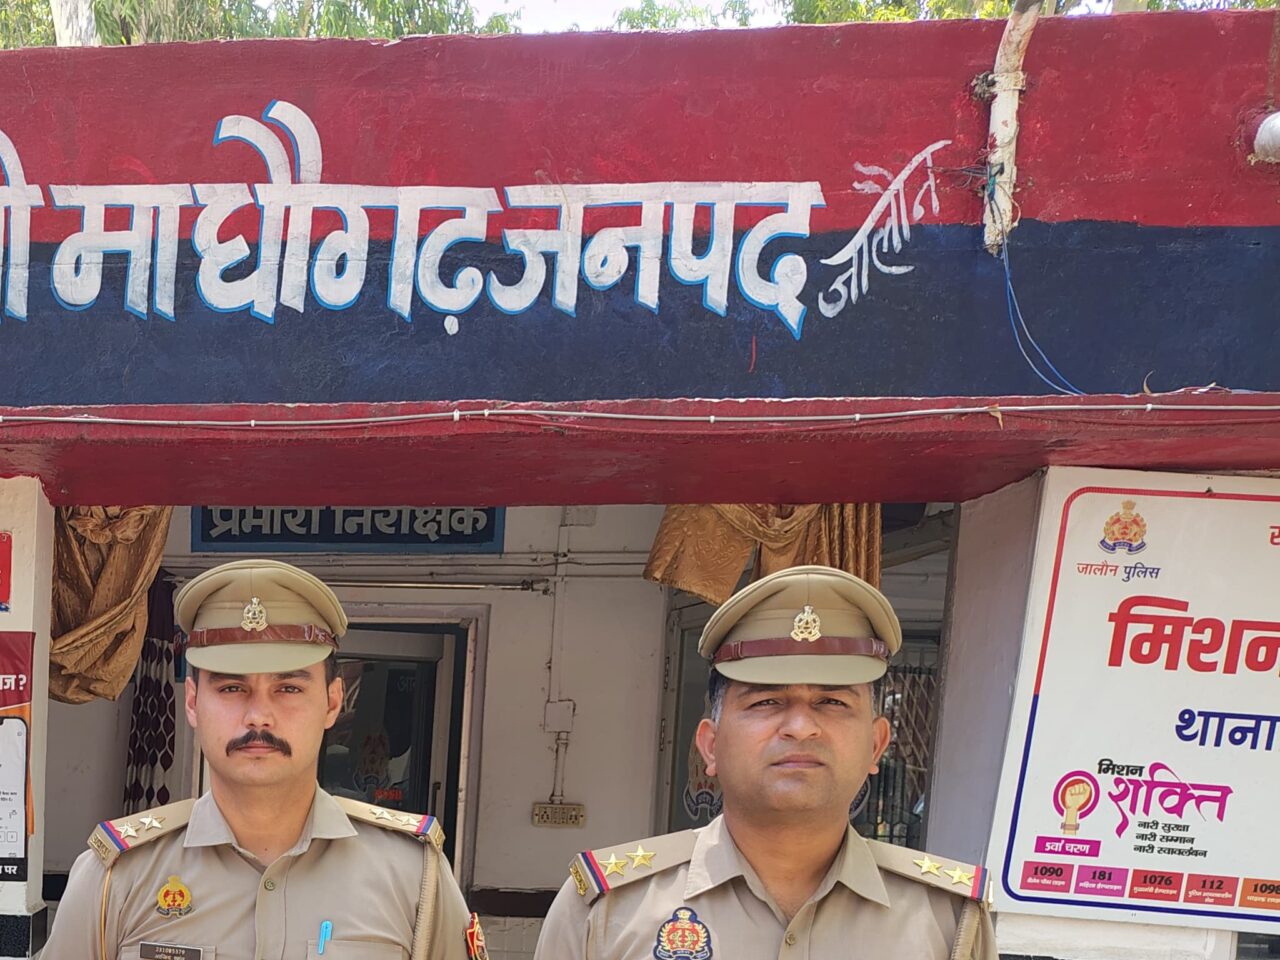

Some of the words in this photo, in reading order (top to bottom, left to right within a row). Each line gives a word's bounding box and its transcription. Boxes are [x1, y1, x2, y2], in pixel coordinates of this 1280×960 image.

[486, 180, 827, 340] जनपद
[1076, 560, 1120, 577] जालौन
[1122, 562, 1161, 583] पुलिस
[1175, 708, 1280, 751] थाना
[1097, 758, 1145, 777] मिशन
[1107, 761, 1234, 839] शक्ति
[1137, 820, 1159, 831] नारी
[1135, 832, 1157, 843] नारी
[1159, 835, 1195, 845] सम्मान
[1065, 844, 1090, 854] चरण
[1133, 844, 1155, 854] नारी
[1157, 846, 1208, 858] स्वावलंबन
[4, 865, 17, 875] पर
[1033, 866, 1063, 877] 1090
[1092, 870, 1113, 881] 181
[1142, 874, 1173, 886] 1076
[1201, 879, 1224, 890] 112
